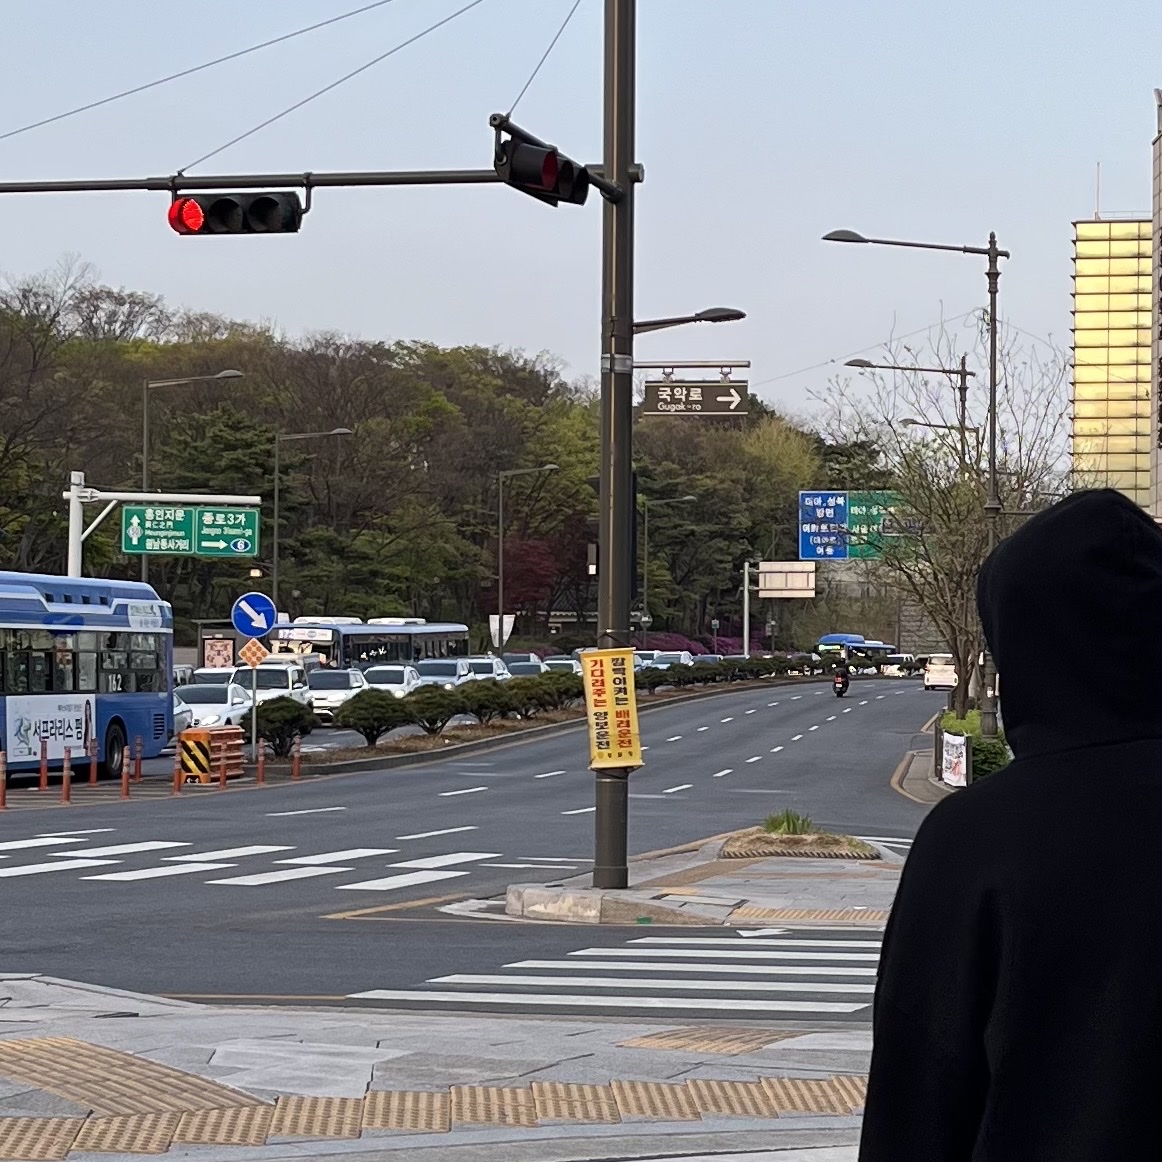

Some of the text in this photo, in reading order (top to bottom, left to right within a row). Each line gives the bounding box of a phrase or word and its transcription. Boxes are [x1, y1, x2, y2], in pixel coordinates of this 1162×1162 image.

[657, 387, 703, 402] 국악로
[657, 402, 702, 412] Gugak-ro
[144, 508, 186, 522] 흥인지문
[201, 511, 247, 526] 종로3가
[237, 540, 245, 550] 6
[108, 674, 122, 691] 162
[590, 659, 611, 750] 기다려주는 양보운전
[615, 709, 632, 749] 배려운전
